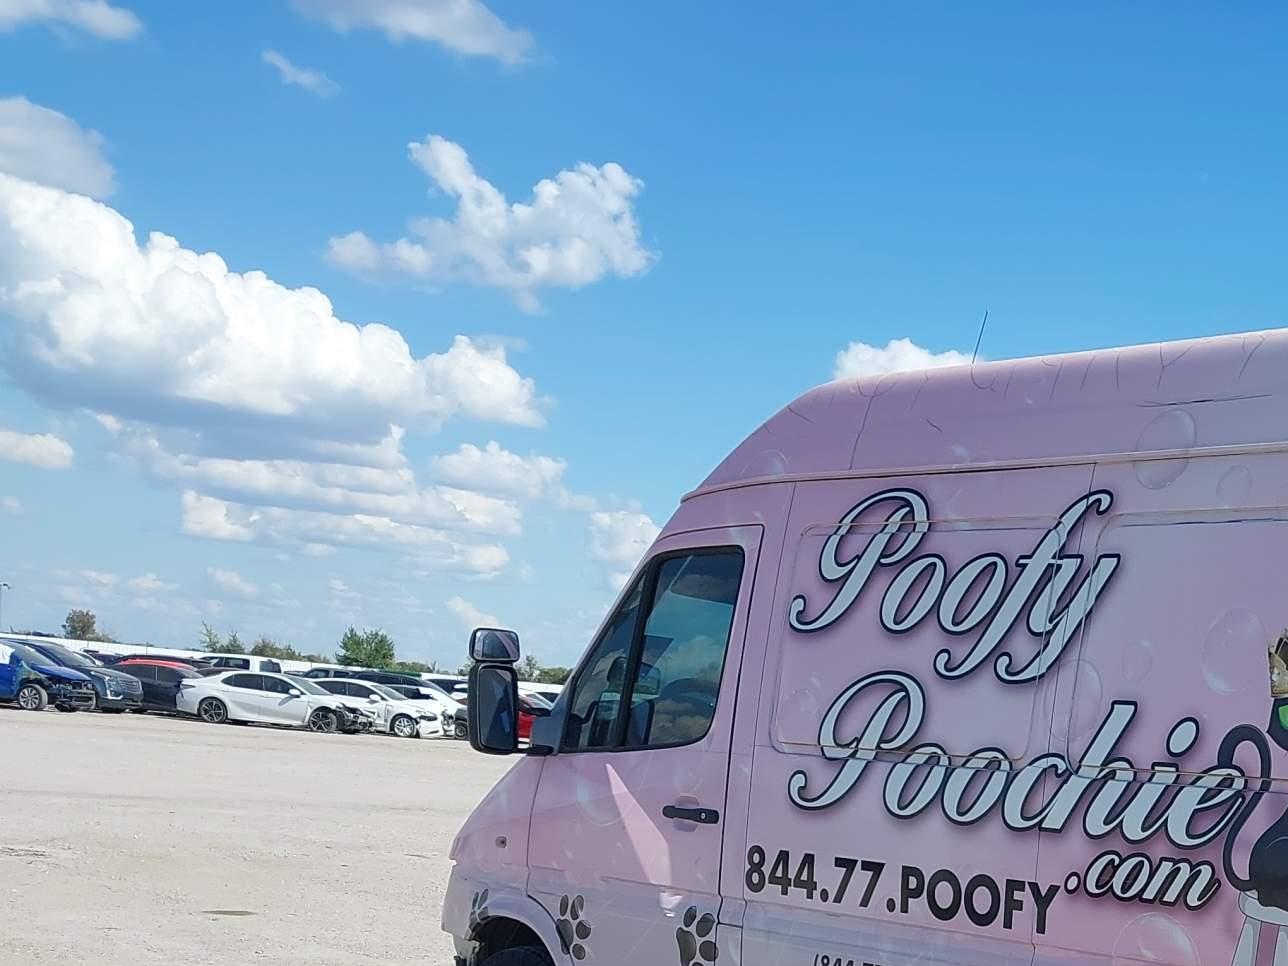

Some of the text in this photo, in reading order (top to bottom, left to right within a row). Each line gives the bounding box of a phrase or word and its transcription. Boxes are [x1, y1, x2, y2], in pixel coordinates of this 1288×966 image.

[788, 487, 1121, 683] Poofy
[788, 670, 1249, 849] Poochie
[745, 845, 1060, 935] 844.77.POOFY
[1063, 849, 1220, 912] .com
